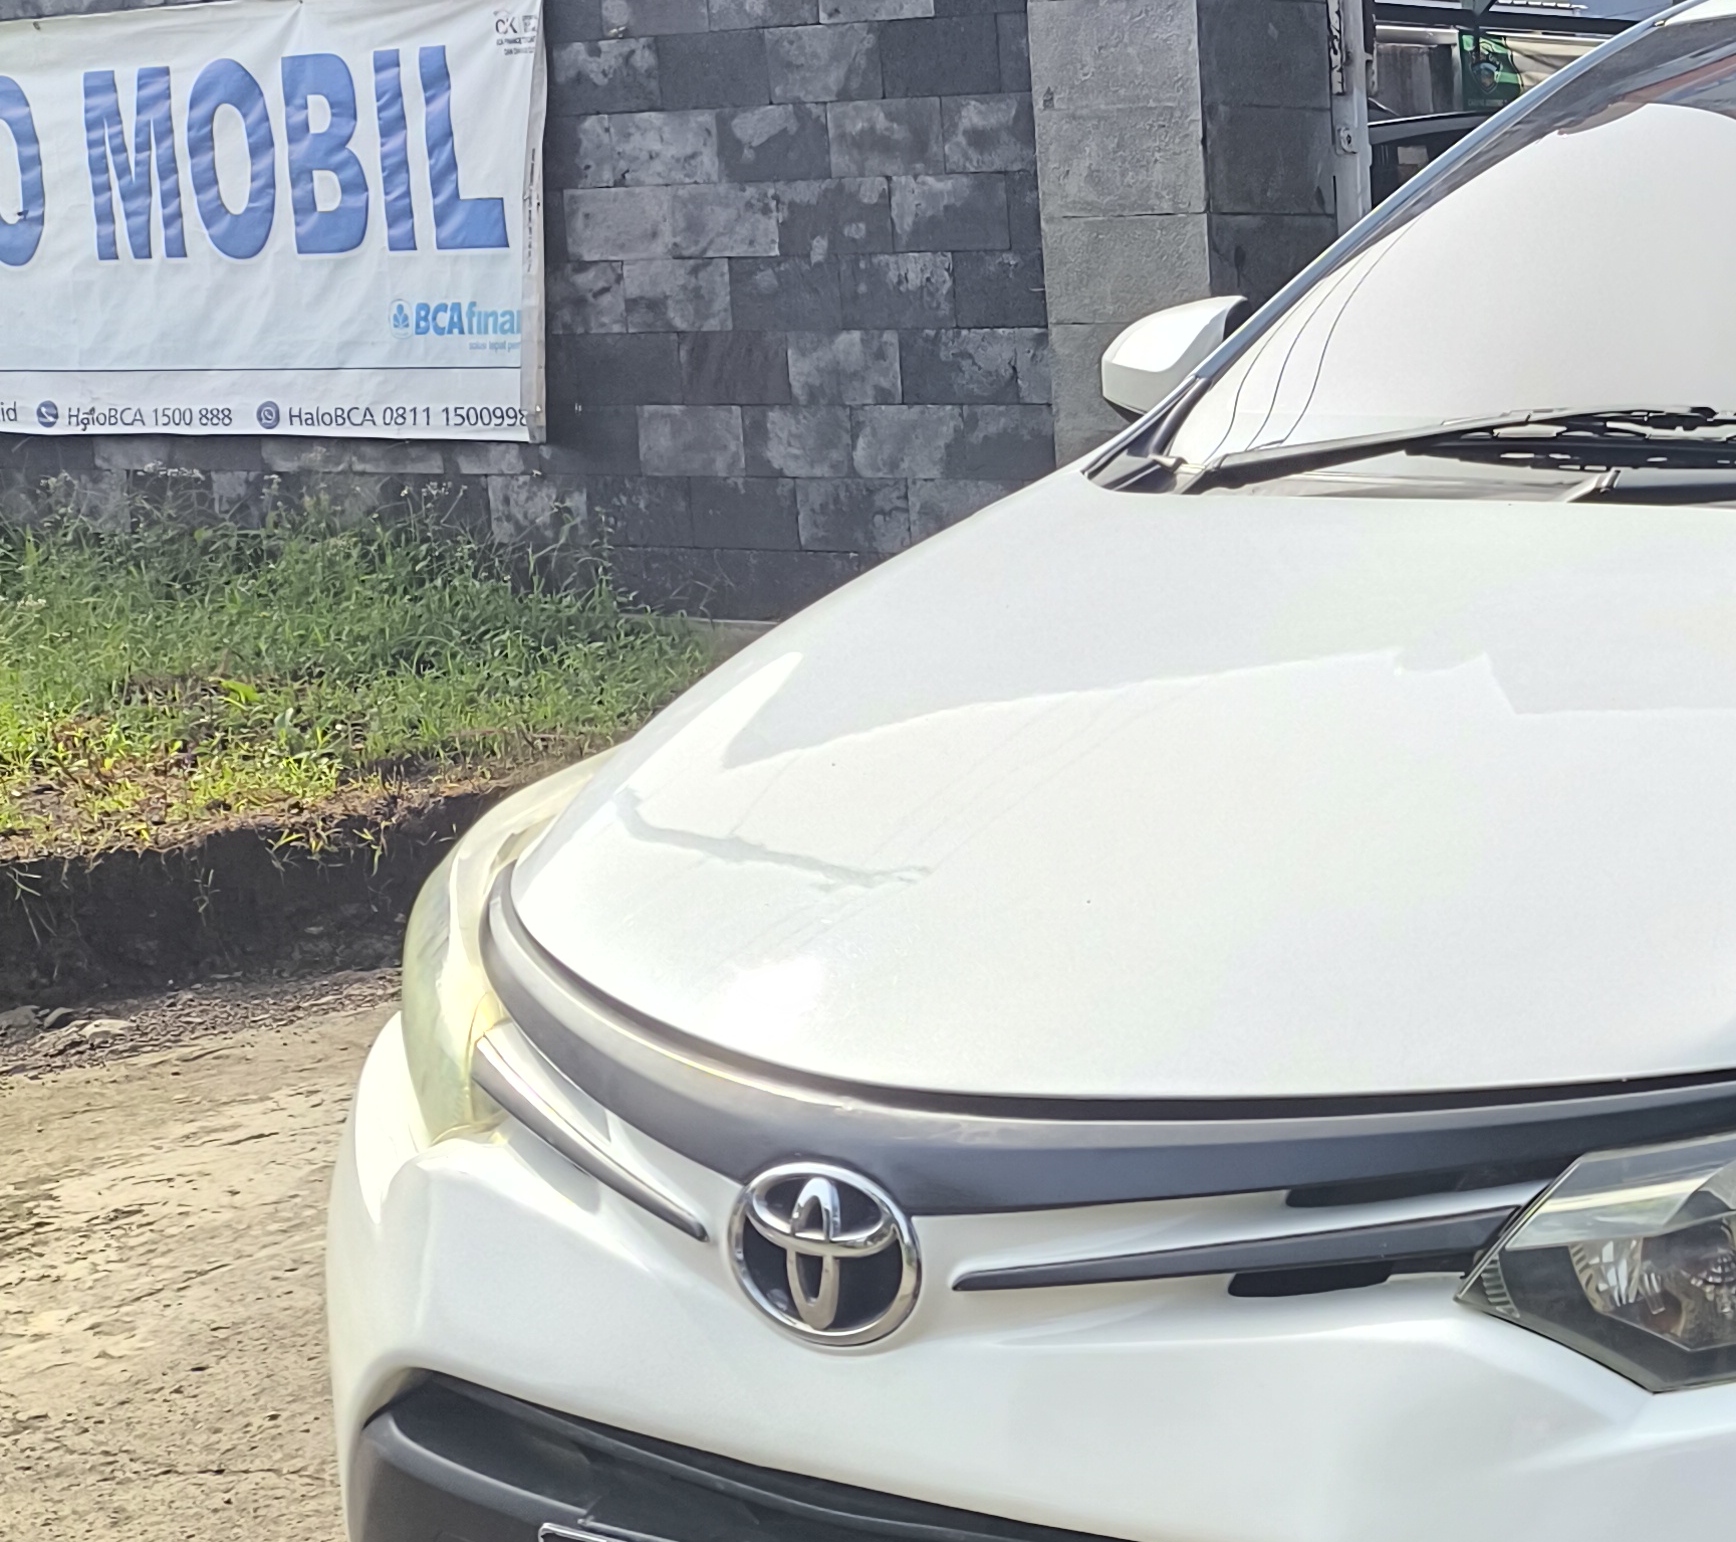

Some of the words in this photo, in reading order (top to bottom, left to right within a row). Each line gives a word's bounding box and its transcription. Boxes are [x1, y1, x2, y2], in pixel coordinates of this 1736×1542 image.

[83, 45, 511, 261] MOBIL
[153, 407, 193, 427] 1500
[199, 407, 233, 427] 888
[289, 405, 377, 428] HaloBCA
[382, 406, 432, 427] 0811
